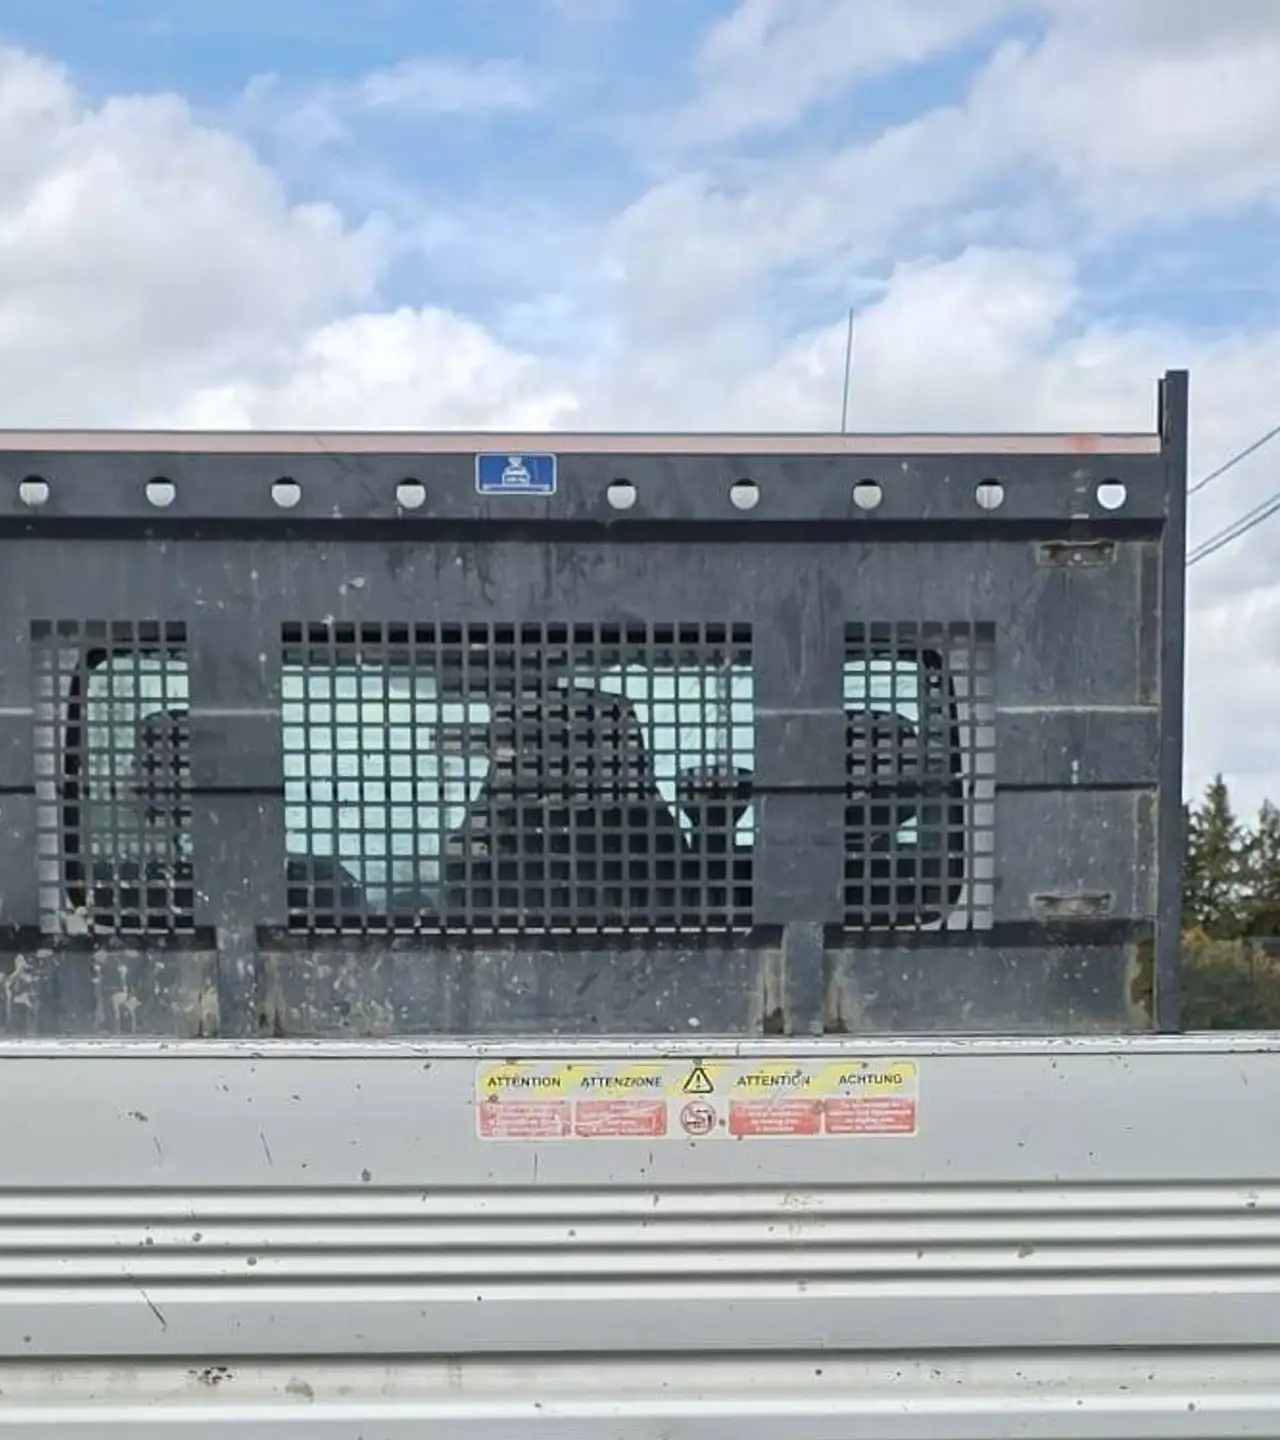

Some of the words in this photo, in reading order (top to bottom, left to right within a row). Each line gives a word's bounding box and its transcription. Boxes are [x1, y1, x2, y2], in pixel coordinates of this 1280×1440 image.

[487, 1075, 561, 1088] ATTENTION
[580, 1075, 663, 1088] ATTENZIONE
[736, 1074, 811, 1087] ATTENTION
[838, 1073, 903, 1085] ACHTUNG
